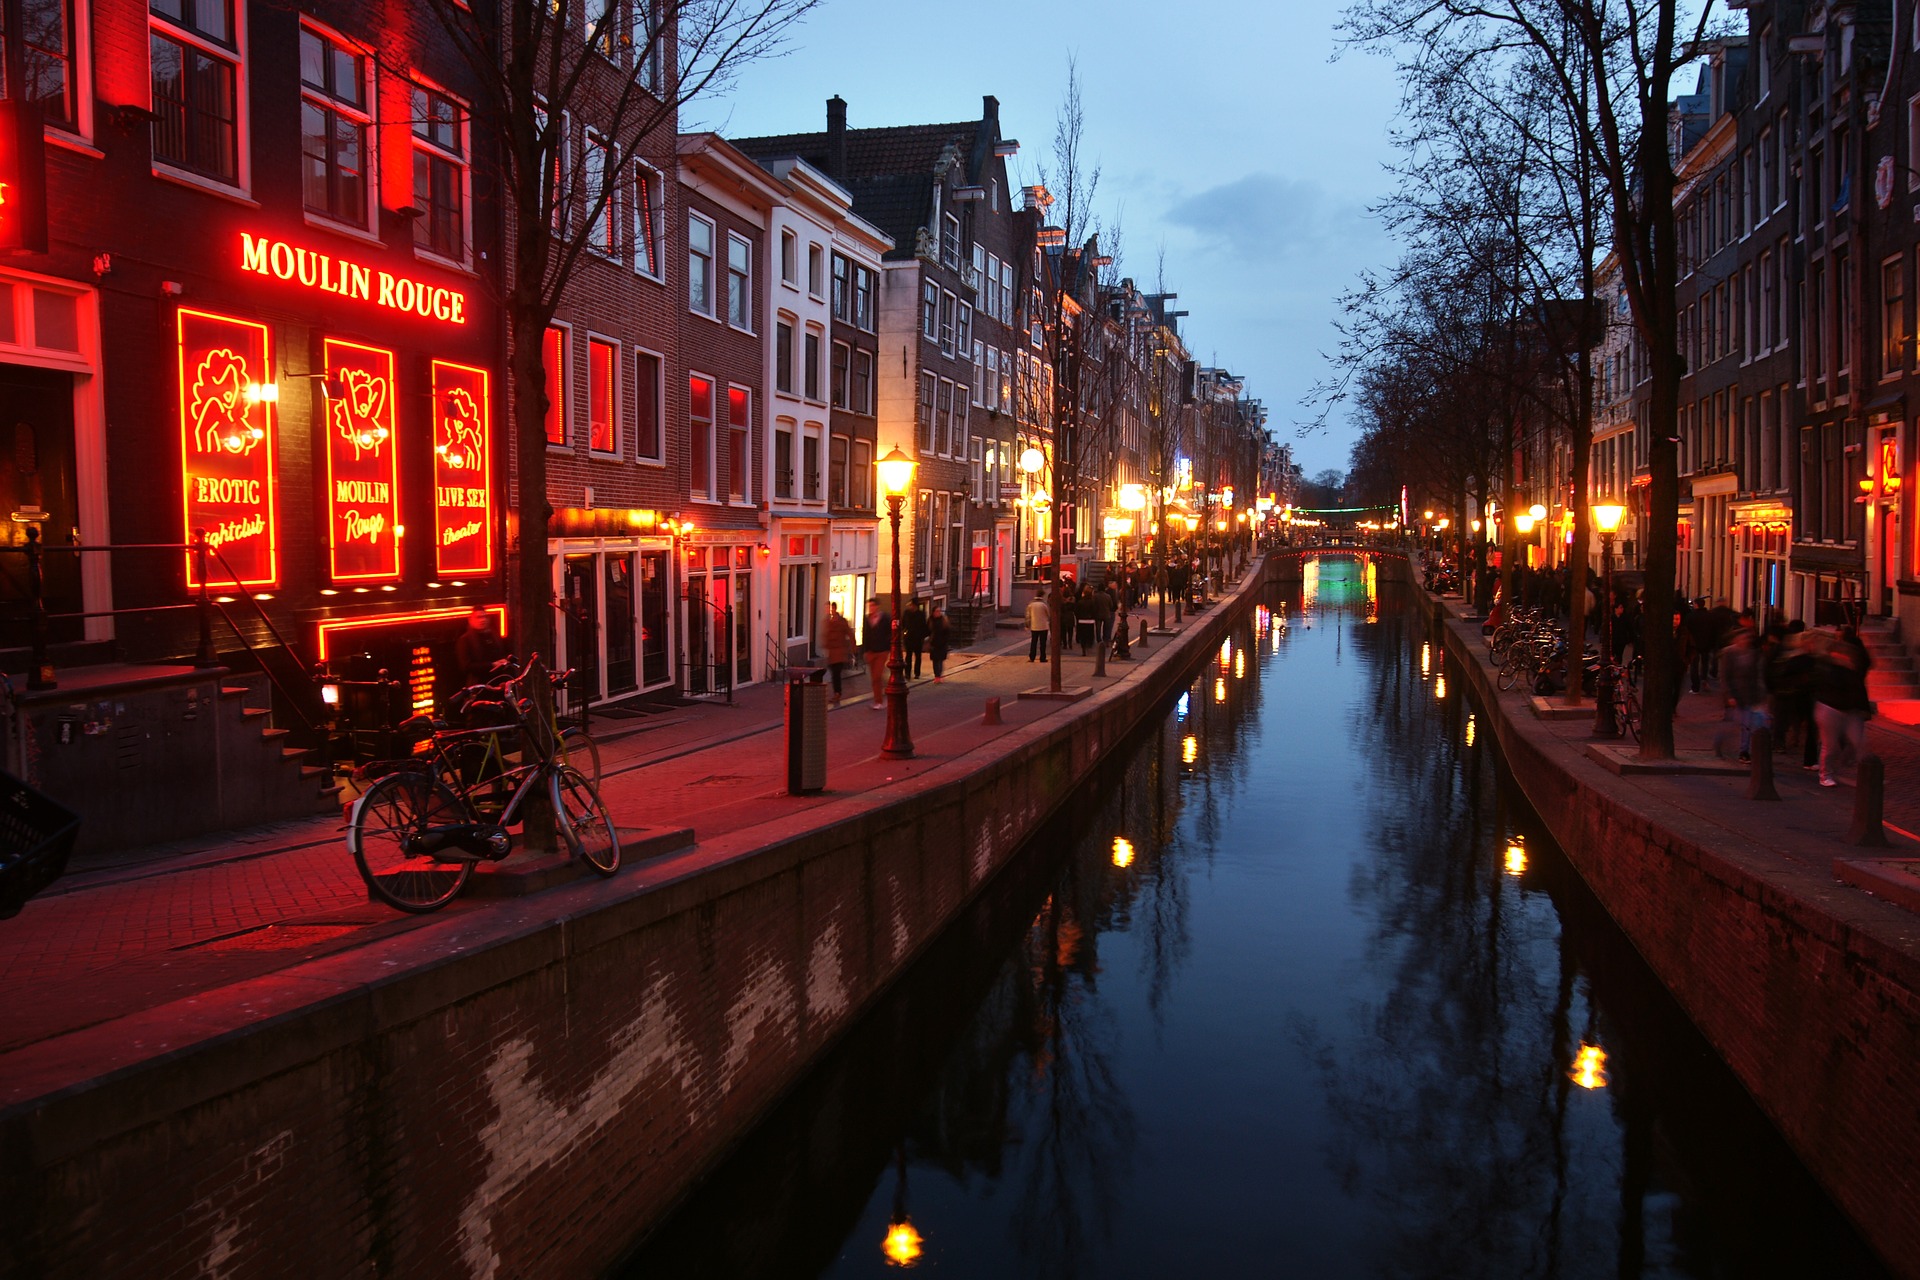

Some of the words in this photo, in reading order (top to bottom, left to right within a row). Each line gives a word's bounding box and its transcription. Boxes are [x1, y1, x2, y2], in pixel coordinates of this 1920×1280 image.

[240, 232, 371, 300] MOULIN
[377, 271, 465, 324] ROUGE
[196, 477, 260, 505] EROTIC
[336, 480, 389, 504] MOULIN
[438, 486, 465, 507] LIVE
[466, 488, 486, 508] SEX
[203, 513, 266, 556] ightclub
[343, 509, 385, 544] Rouge
[442, 521, 483, 546] theater
